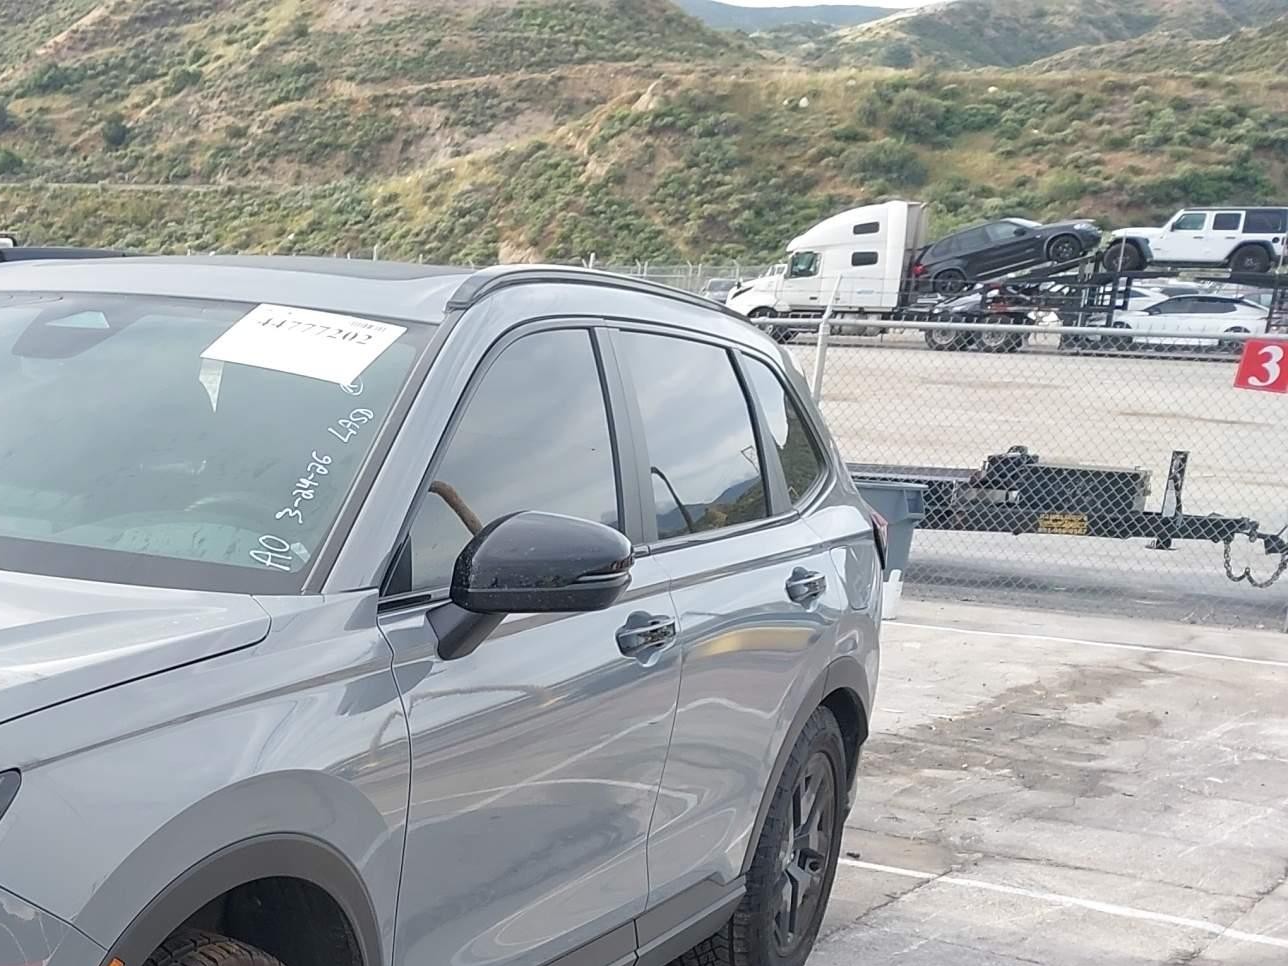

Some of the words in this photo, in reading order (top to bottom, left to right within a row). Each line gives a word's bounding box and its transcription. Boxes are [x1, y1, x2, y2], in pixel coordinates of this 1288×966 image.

[257, 317, 373, 345] 44777202
[1247, 345, 1284, 387] 3
[275, 451, 332, 524] 3-24-26
